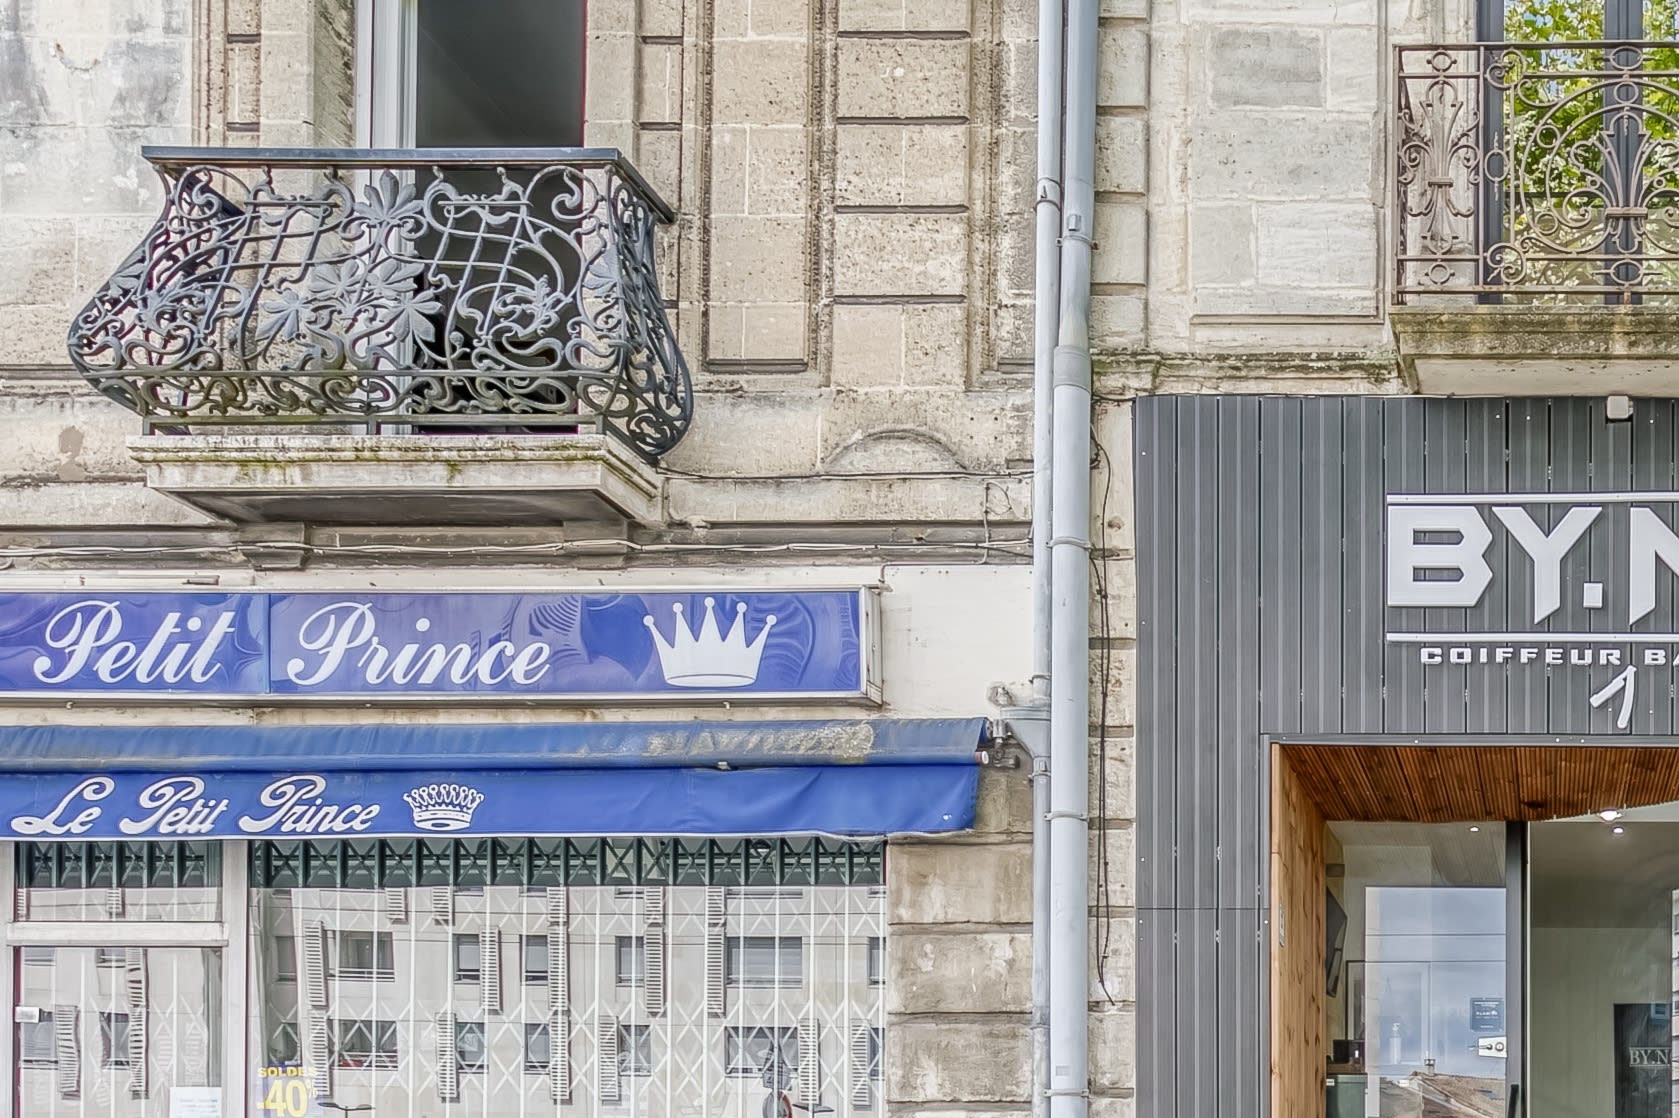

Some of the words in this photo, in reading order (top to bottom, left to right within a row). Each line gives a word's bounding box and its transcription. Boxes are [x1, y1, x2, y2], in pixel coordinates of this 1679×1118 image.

[33, 600, 236, 684] Petit
[287, 601, 551, 686] Prince
[1420, 647, 1621, 667] COIFFEUR
[11, 776, 116, 835] Le
[119, 776, 230, 835] Petit
[239, 775, 381, 833] Prince
[1629, 1049, 1673, 1065] BY.N
[258, 1067, 318, 1077] SOLDES
